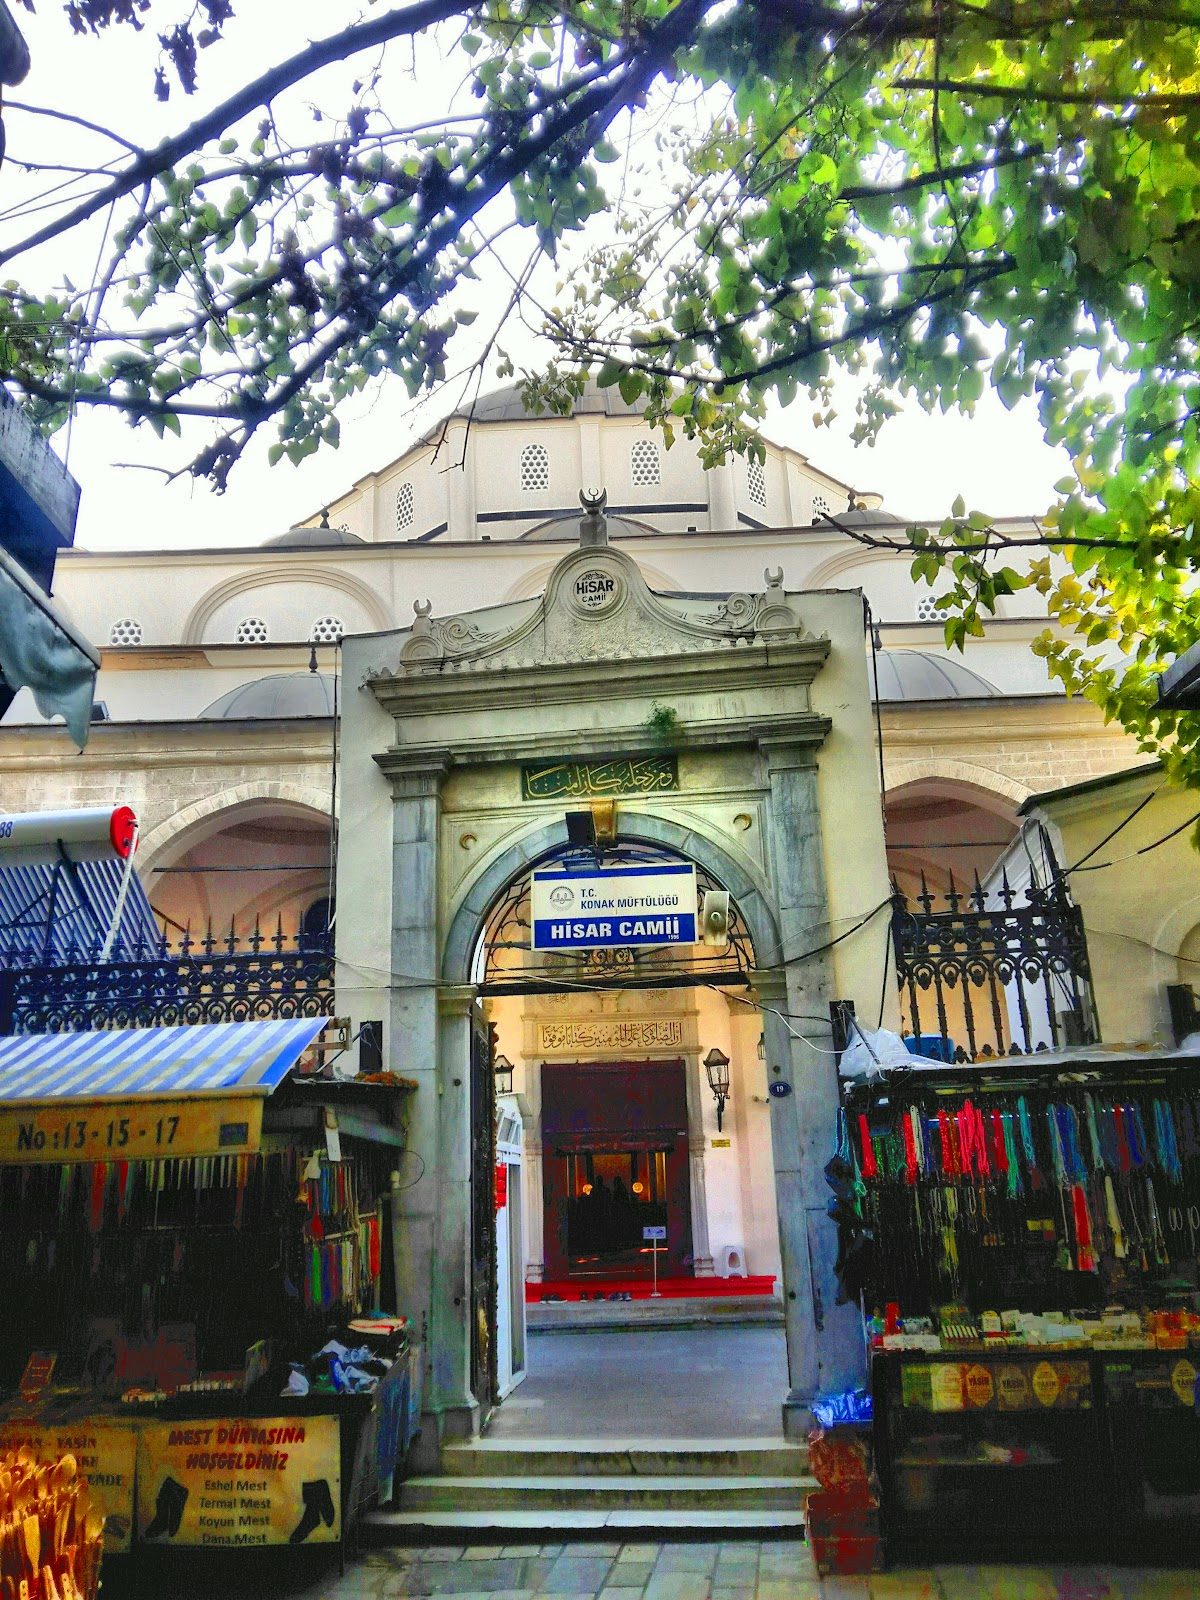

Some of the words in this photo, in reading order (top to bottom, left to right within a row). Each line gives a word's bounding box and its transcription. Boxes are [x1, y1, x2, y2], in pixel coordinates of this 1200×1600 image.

[580, 888, 597, 898] T.C.
[580, 899, 615, 910] KONAK
[617, 894, 679, 908] MÜFTÜLÜĞÜ
[551, 921, 612, 940] HİSAR
[619, 917, 680, 938] CAMİİ
[776, 1085, 784, 1093] 19
[168, 1429, 213, 1447] MEST
[236, 1480, 267, 1491] Mest
[200, 1498, 237, 1509] Termal
[240, 1498, 271, 1509] Mest
[200, 1516, 234, 1529] Koyun
[239, 1516, 270, 1526] Mest
